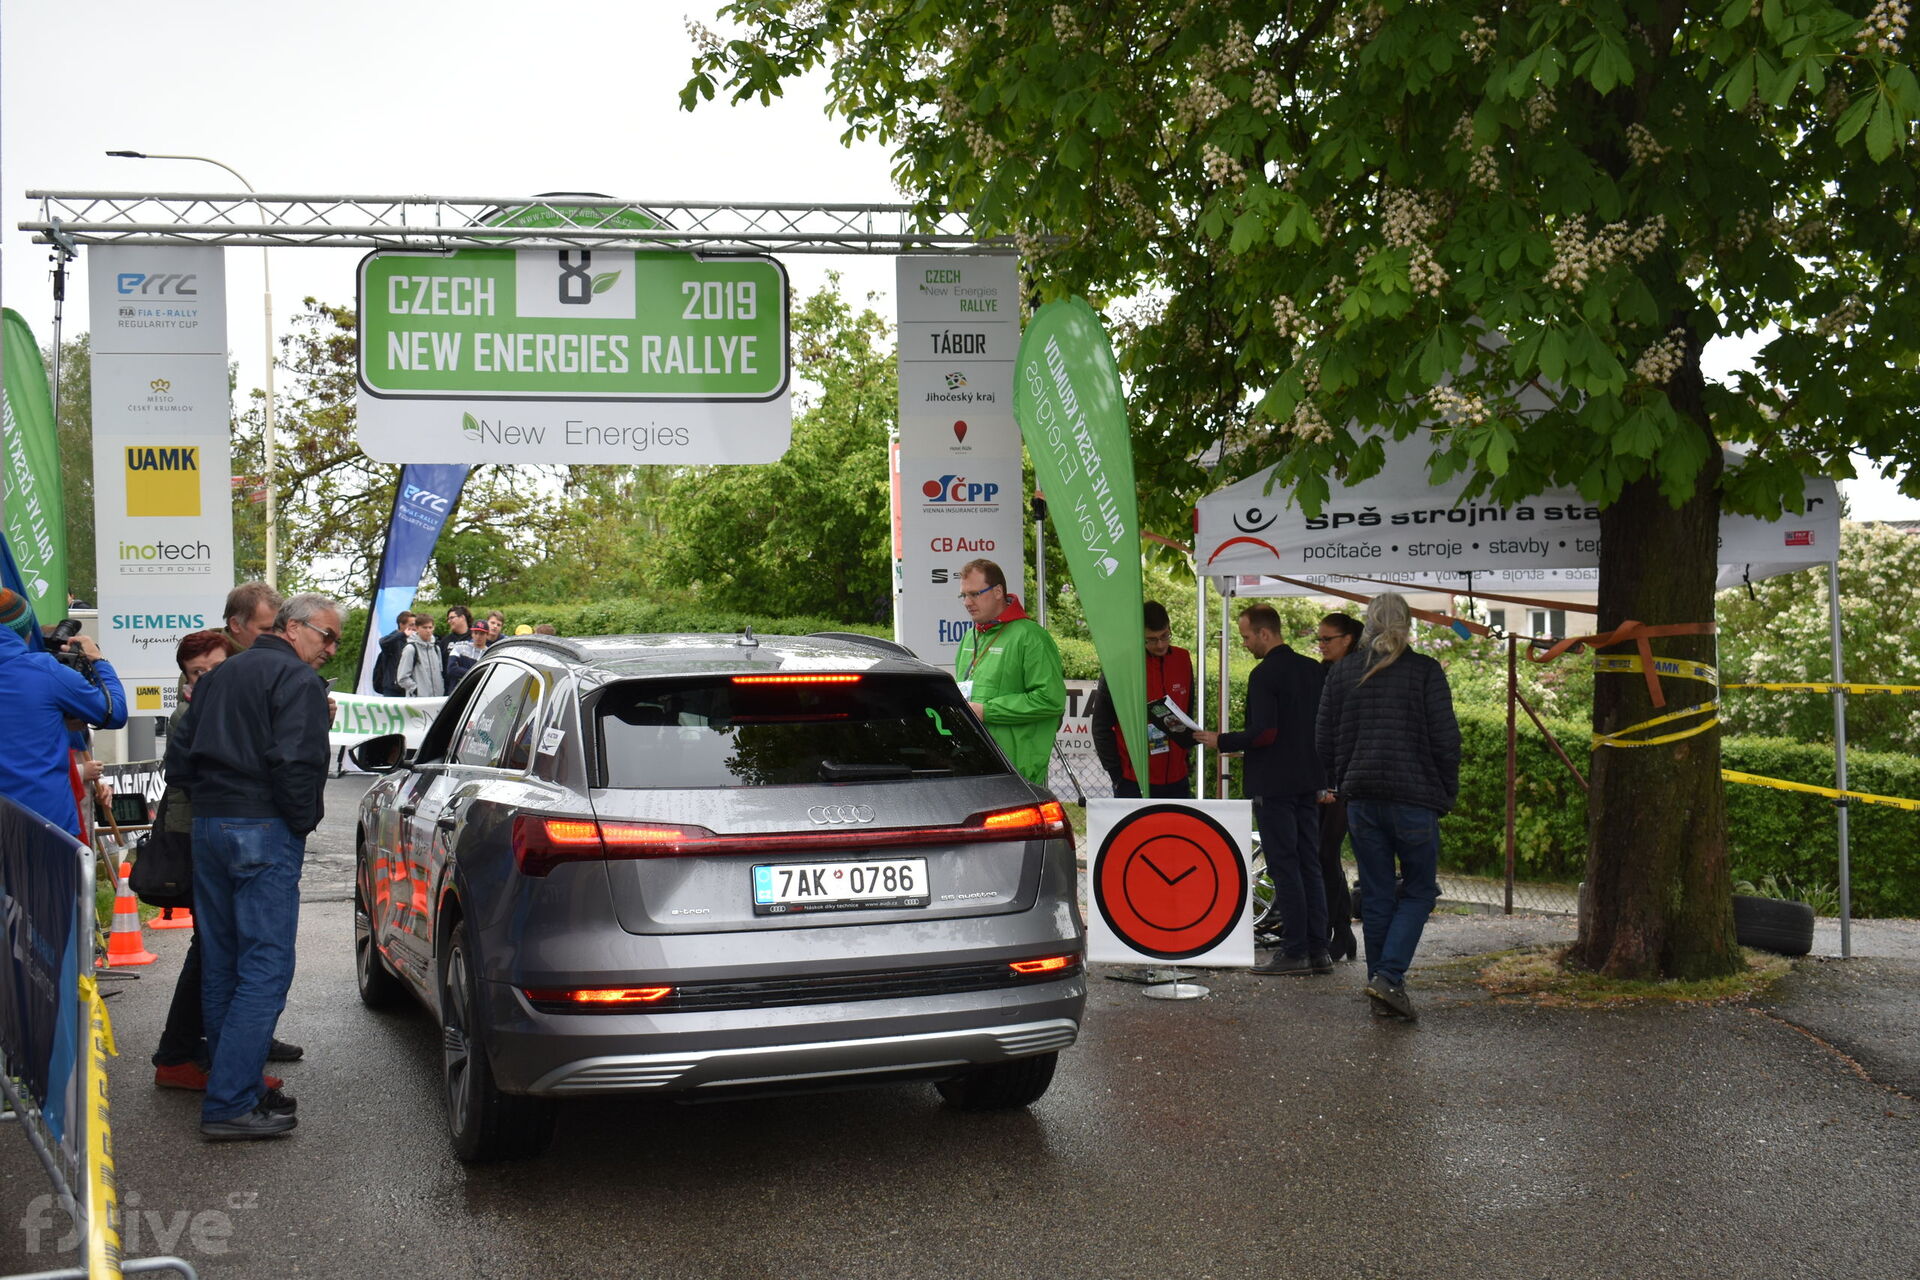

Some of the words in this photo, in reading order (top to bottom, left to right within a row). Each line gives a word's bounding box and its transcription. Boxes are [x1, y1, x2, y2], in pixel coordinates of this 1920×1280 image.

[926, 270, 961, 284] CZECH
[388, 275, 495, 316] CZECH
[681, 280, 757, 320] 2019
[926, 286, 948, 296] New
[954, 286, 998, 298] Energies
[960, 299, 998, 312] RALLYE
[138, 309, 153, 317] FIA
[156, 309, 198, 318] E-RALLY
[118, 320, 177, 329] REGULARITY
[179, 320, 199, 329] CUP
[931, 329, 986, 354] TÁBOR
[388, 331, 462, 371] NEW
[474, 332, 629, 374] ENERGIES
[642, 335, 758, 375] RALLYE
[147, 395, 174, 403] MĚSTO
[925, 392, 973, 404] Jihočeský
[976, 392, 996, 403] kraj
[128, 404, 150, 412] ČESKÝ
[154, 404, 193, 412] KRUMLOV
[480, 419, 546, 446] New
[565, 420, 690, 451] Energies
[127, 448, 198, 471] UAMK
[950, 477, 999, 502] ČPP
[1305, 506, 1382, 531] SPŠ
[1516, 506, 1535, 521] a
[1544, 503, 1600, 521] sta
[119, 540, 211, 560] inotech
[930, 537, 953, 552] CB
[956, 537, 995, 552] Auto
[1303, 542, 1382, 562] počítače
[1408, 540, 1463, 560] stroje
[1489, 537, 1550, 557] stavby
[112, 614, 205, 629] SIEMENS
[132, 634, 183, 650] Ingenuity
[1655, 661, 1680, 674] AMK
[136, 687, 160, 696] UAMK
[1063, 723, 1089, 734] AM
[1058, 740, 1092, 749] TADO
[778, 868, 828, 898] 7AK
[850, 864, 915, 894] 0786
[958, 891, 998, 900] quattro
